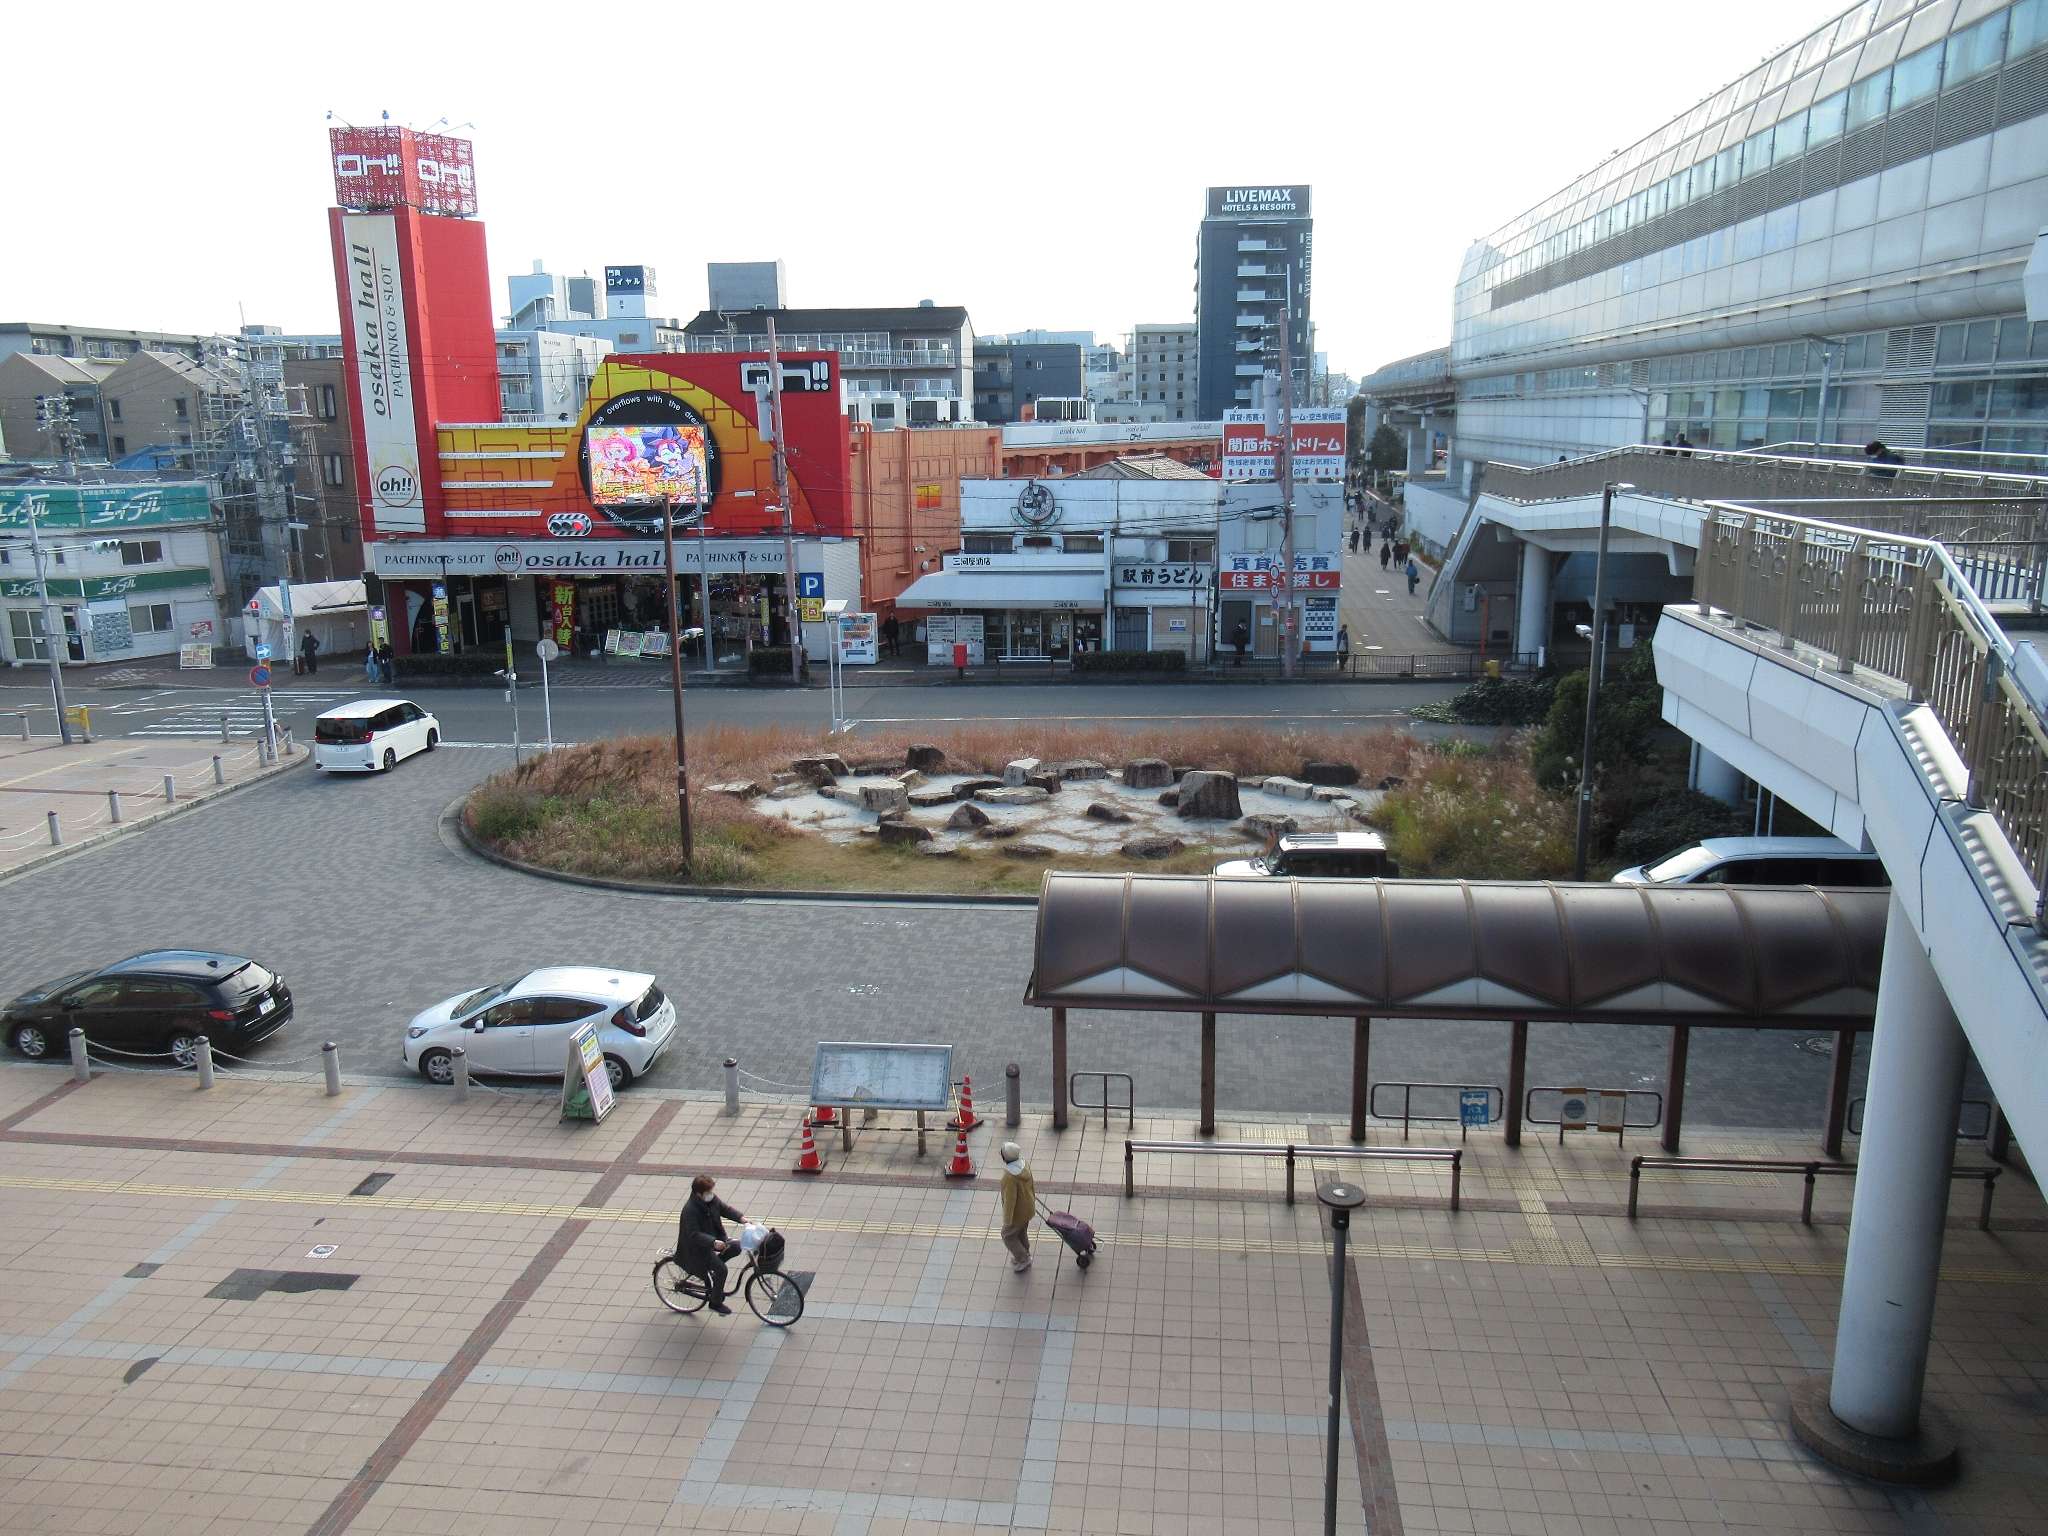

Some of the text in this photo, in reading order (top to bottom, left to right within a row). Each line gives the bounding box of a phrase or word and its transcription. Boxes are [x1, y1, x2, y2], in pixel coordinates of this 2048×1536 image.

[1221, 204, 1251, 212] HOTELS
[1260, 203, 1296, 211] RESORTS
[381, 265, 396, 303] SLOT
[608, 277, 641, 286] ロイヤル
[352, 243, 387, 418] osaka hall
[385, 319, 405, 399] PACHINKO
[606, 395, 641, 415] overflows
[646, 395, 664, 404] with
[668, 400, 682, 411] the
[1228, 437, 1341, 453] 関西ホードリーム
[380, 478, 412, 492] oh!!
[90, 490, 162, 524] エイブル
[385, 555, 446, 565] PACHINKO
[457, 554, 486, 565] SLOT
[496, 551, 519, 563] oh!!
[525, 549, 668, 567] osaka hal
[686, 552, 747, 563] PAHINKO
[760, 553, 786, 563] SLO
[98, 575, 137, 595] エイブル
[1122, 567, 1204, 585] 駅前うどん
[805, 576, 819, 596] P
[554, 586, 575, 647] 新台入替
